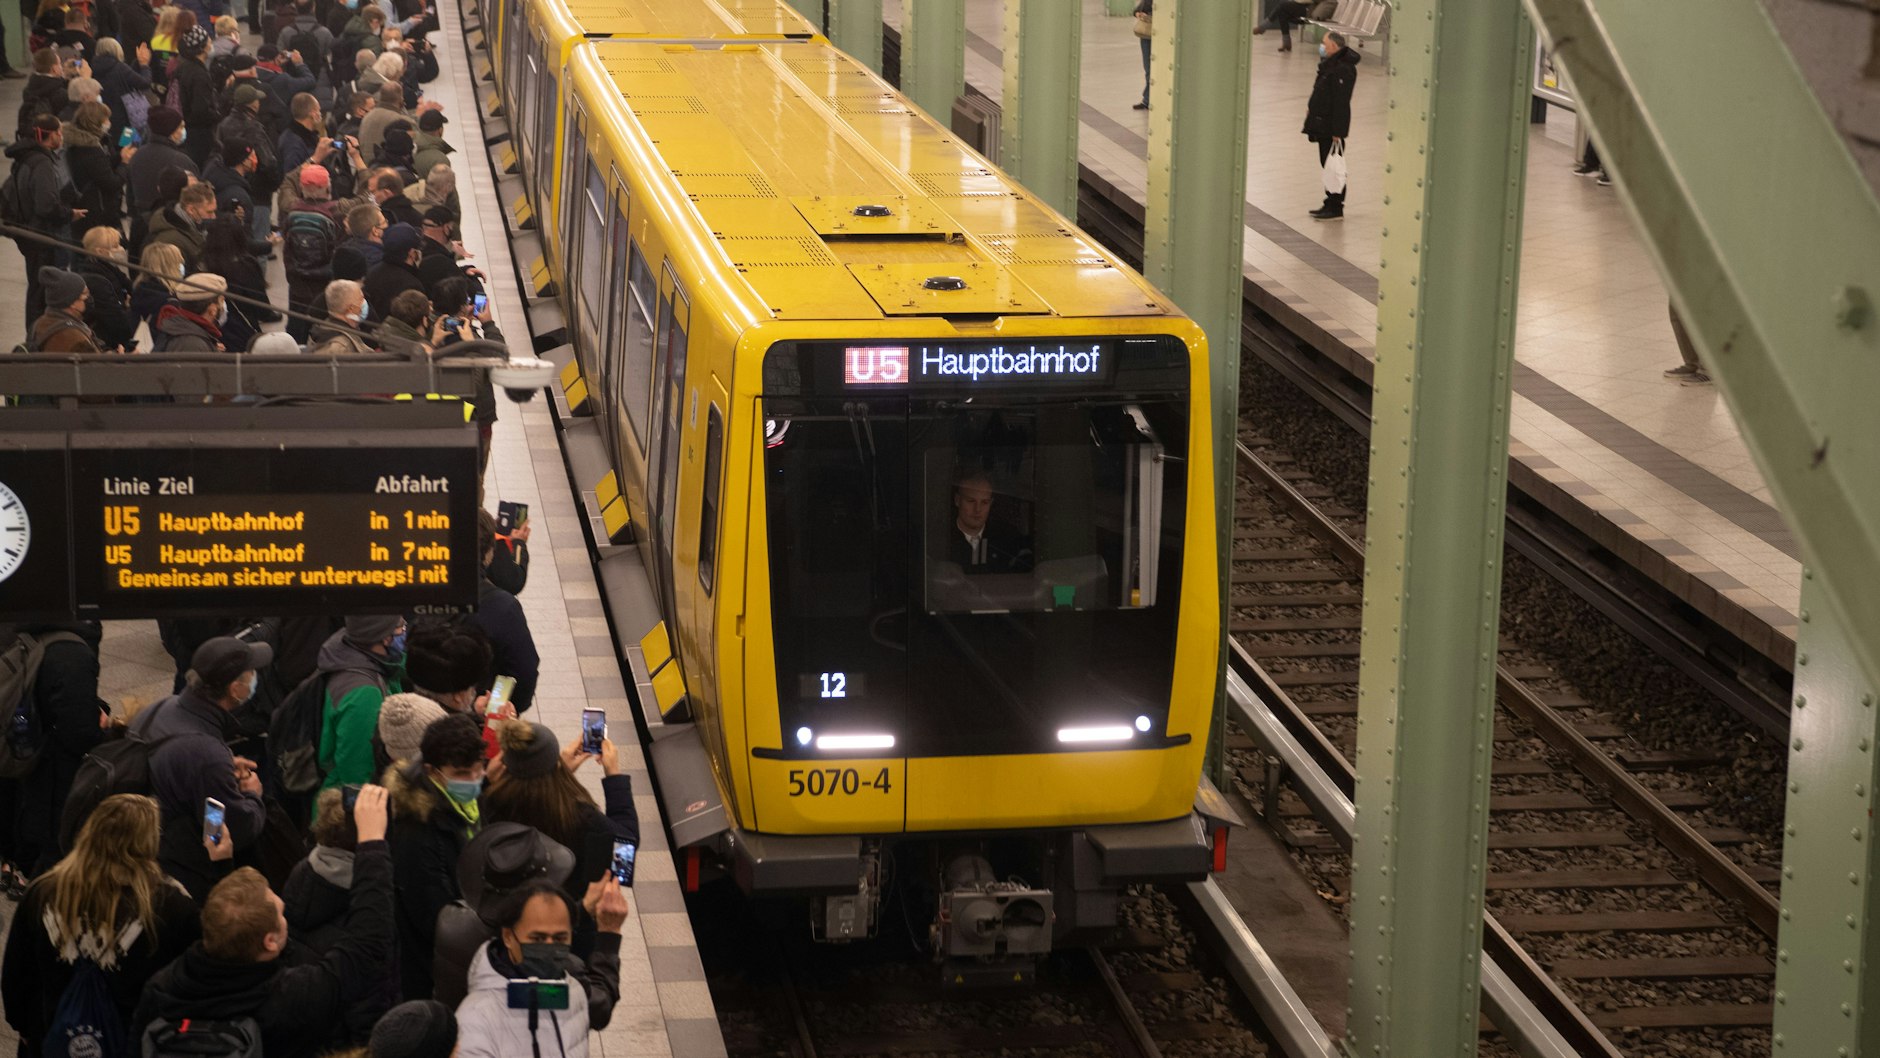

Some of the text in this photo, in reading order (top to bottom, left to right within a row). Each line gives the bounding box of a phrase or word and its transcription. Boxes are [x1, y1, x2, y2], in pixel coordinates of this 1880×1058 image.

[852, 345, 1101, 381] U5 Hauptbahnhof
[104, 475, 449, 496] Linie Ziel Abfahrt
[104, 506, 450, 535] U5 Hauptbahnhof in 1 min
[105, 542, 450, 566] U5 Hauptbahnhof in 7 min
[119, 566, 448, 588] Gemeinsam sicher unterwegs! mit
[413, 604, 474, 614] Gleis 1
[820, 672, 846, 698] 12
[789, 767, 892, 797] 5070-4
